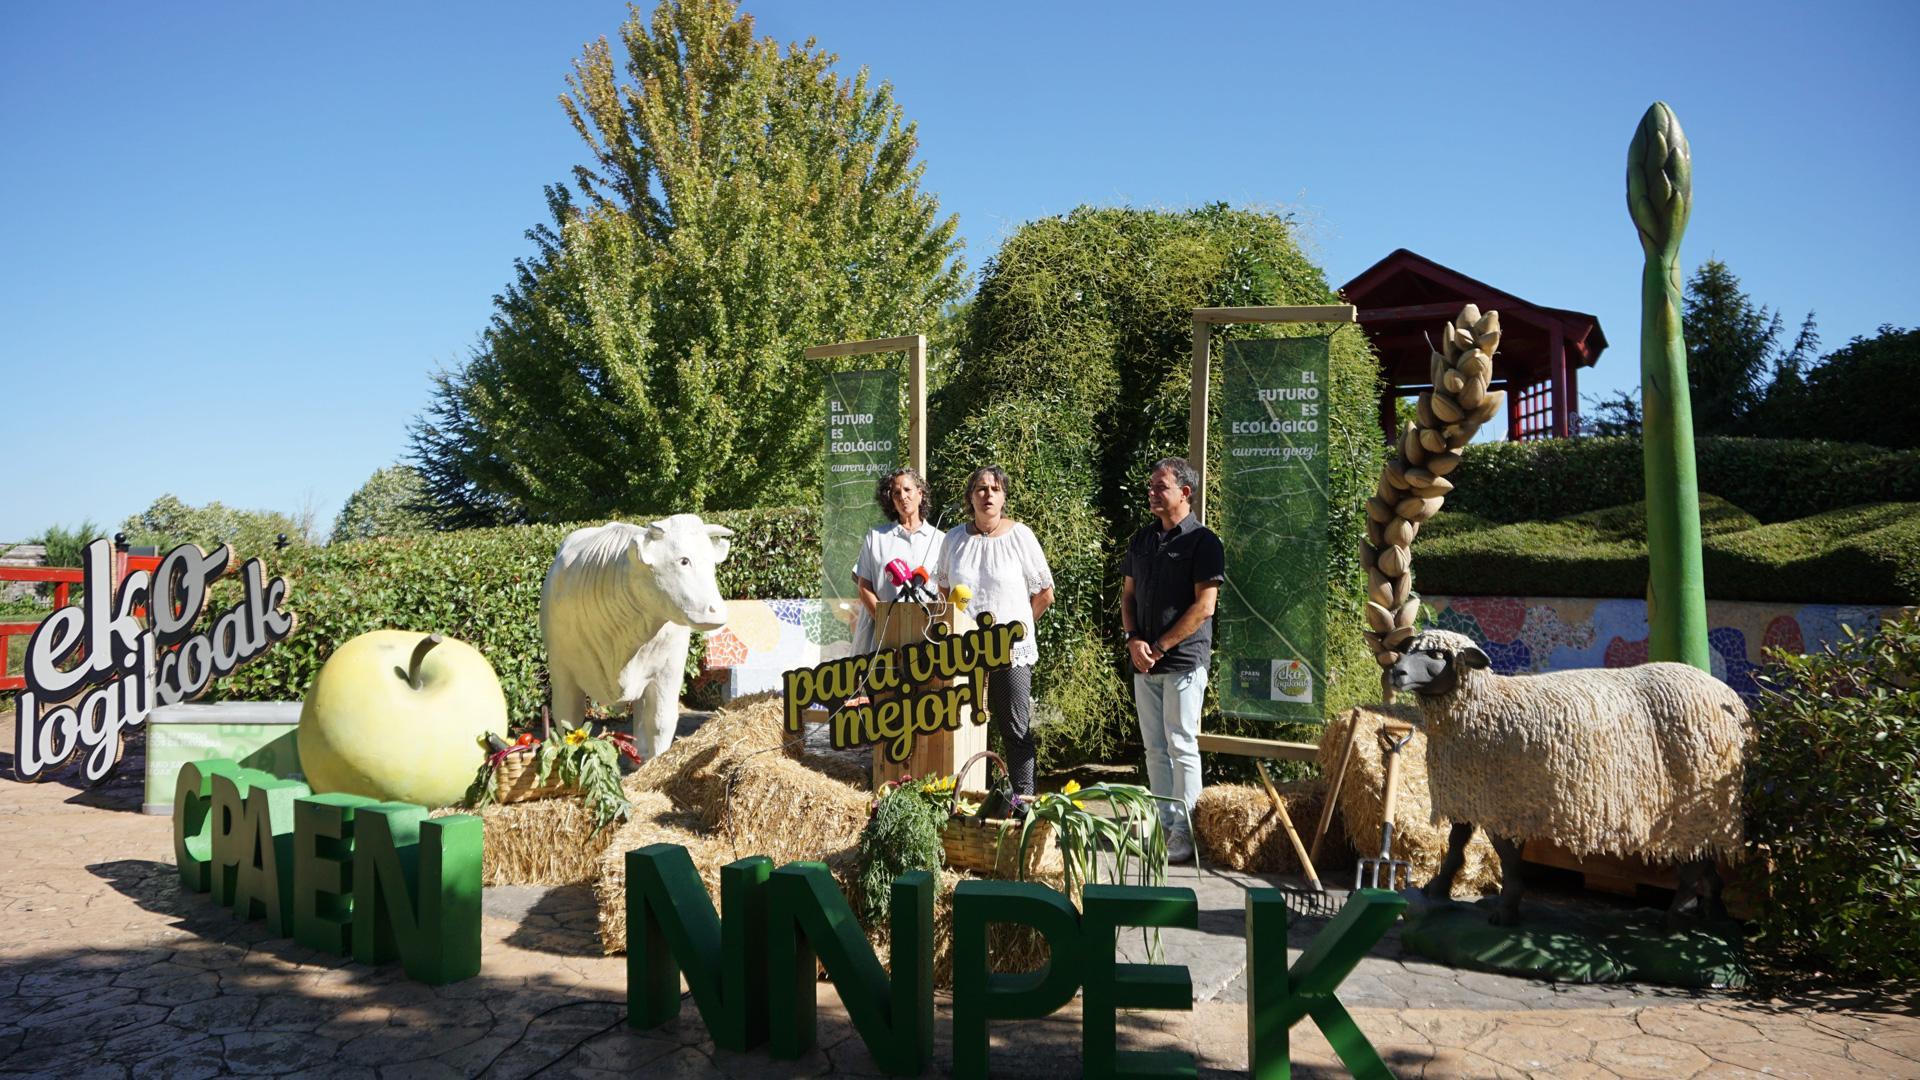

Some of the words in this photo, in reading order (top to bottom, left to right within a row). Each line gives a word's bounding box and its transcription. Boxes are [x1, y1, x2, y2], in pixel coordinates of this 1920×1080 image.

[1302, 371, 1319, 384] EL
[1259, 387, 1319, 401] FUTURO
[831, 401, 844, 412] EL
[1302, 403, 1319, 416] ES
[831, 413, 874, 426] FUTURO
[831, 428, 844, 439] ES
[831, 438, 892, 453] ECOLÓGICO
[1232, 447, 1281, 457] aurrera
[1283, 443, 1319, 461] goaz!
[831, 463, 866, 472] aurrera
[866, 460, 892, 476] goaz!
[20, 556, 294, 782] logikoak
[786, 650, 901, 734] para
[908, 612, 1025, 683] vivir
[834, 666, 988, 762] mejor!
[173, 760, 483, 985] CPAEN
